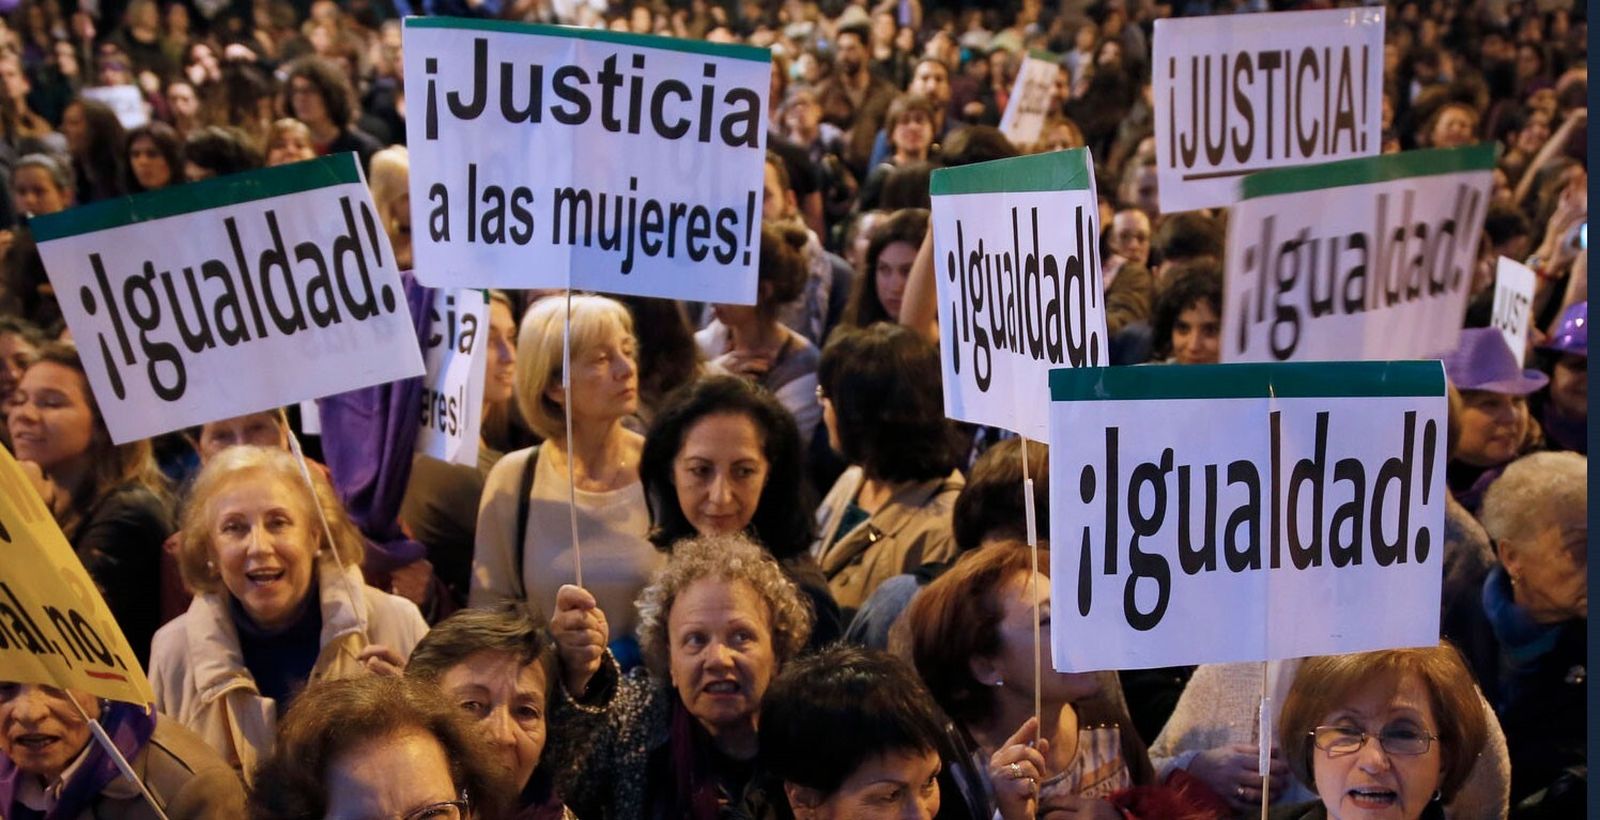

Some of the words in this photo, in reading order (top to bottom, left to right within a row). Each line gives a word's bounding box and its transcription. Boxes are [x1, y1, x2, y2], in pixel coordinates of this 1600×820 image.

[426, 38, 760, 149] ¡Justicia
[1169, 45, 1369, 169] ¡JUSTICIA!
[80, 196, 397, 402] ¡Igualdad!
[429, 183, 450, 242] a
[468, 163, 534, 246] las
[553, 177, 756, 275] mujeres!
[948, 205, 1099, 393] ¡Igualdad!
[1237, 183, 1481, 361] ¡Igualdad!
[1077, 410, 1437, 632] ¡Igualdad!
